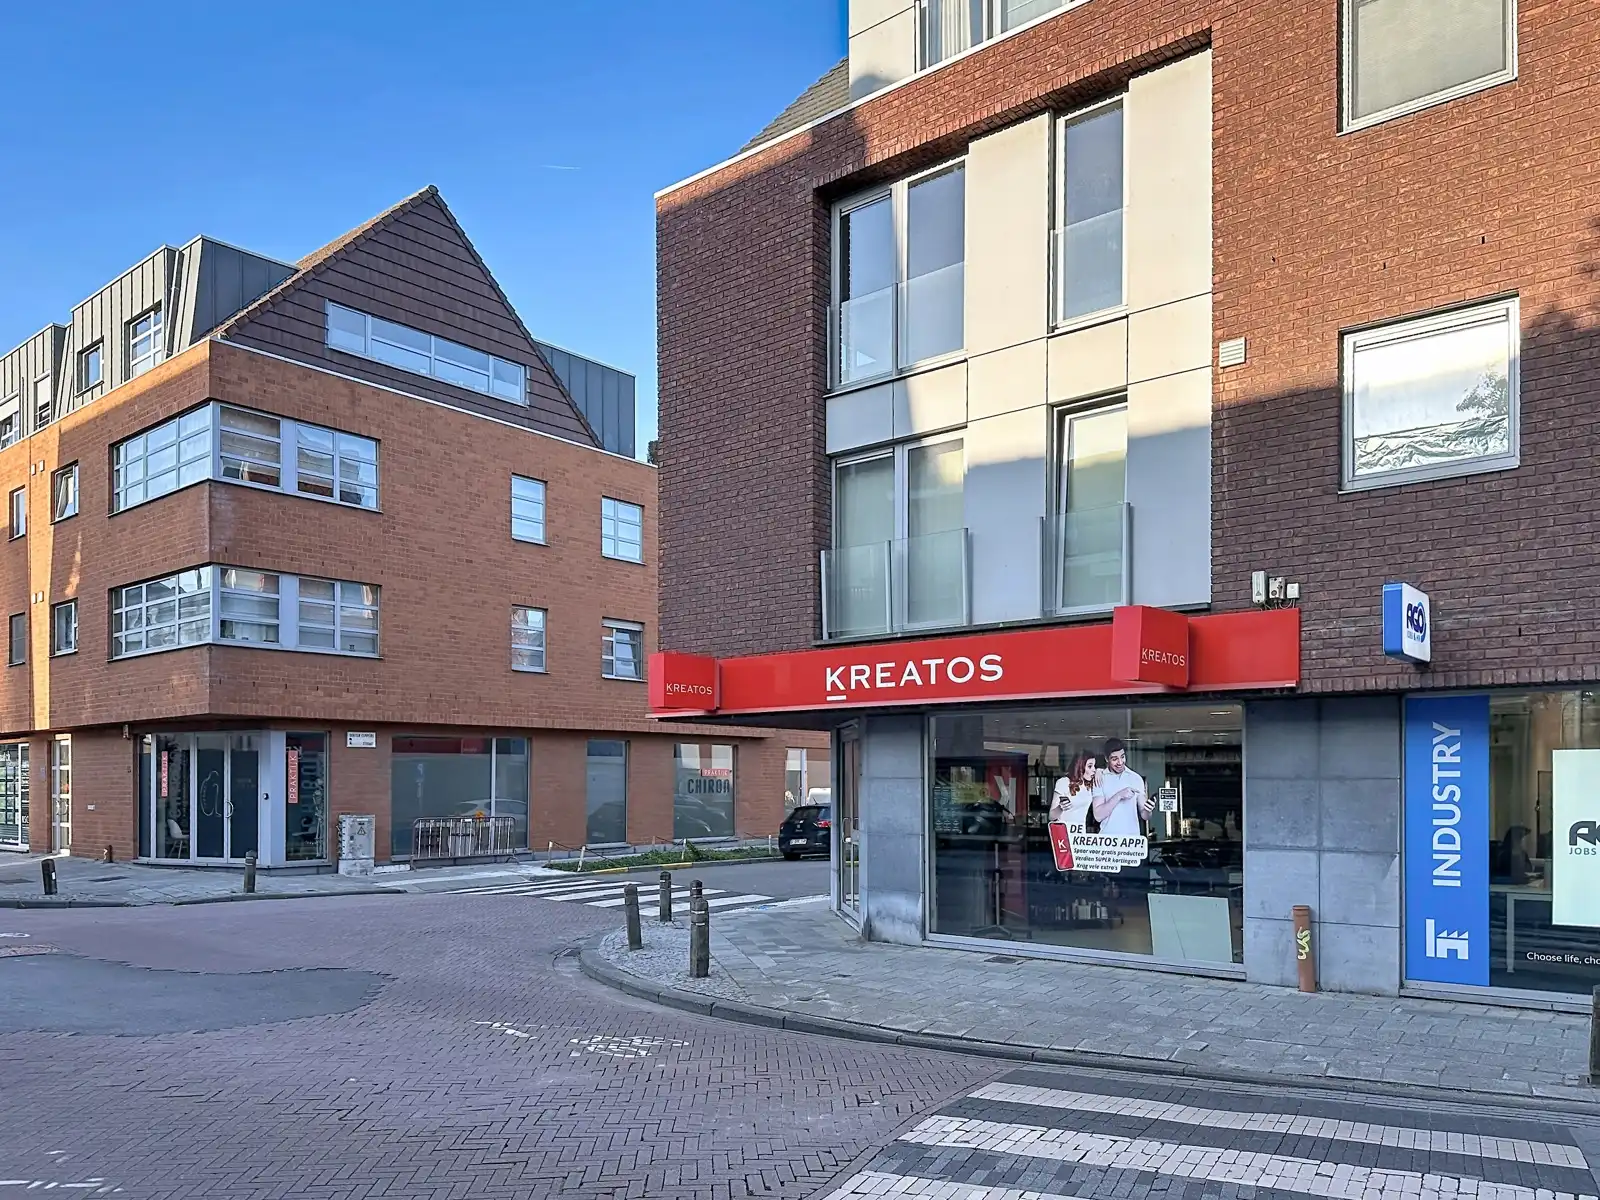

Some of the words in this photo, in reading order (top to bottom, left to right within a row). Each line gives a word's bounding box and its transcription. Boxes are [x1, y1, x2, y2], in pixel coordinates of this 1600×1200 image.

[1407, 602, 1425, 634] AGO
[1141, 648, 1186, 667] KREATOS
[826, 654, 1003, 701] KREATOS
[666, 683, 713, 695] KREATOS
[1432, 721, 1461, 886] INDUSTRY
[1070, 824, 1084, 834] DE
[1072, 836, 1118, 848] KREATOS
[1120, 837, 1145, 849] APP!
[1569, 847, 1597, 856] JOBS
[1112, 857, 1138, 865] kortingen
[1526, 951, 1562, 962] Choose
[1564, 954, 1582, 965] life,
